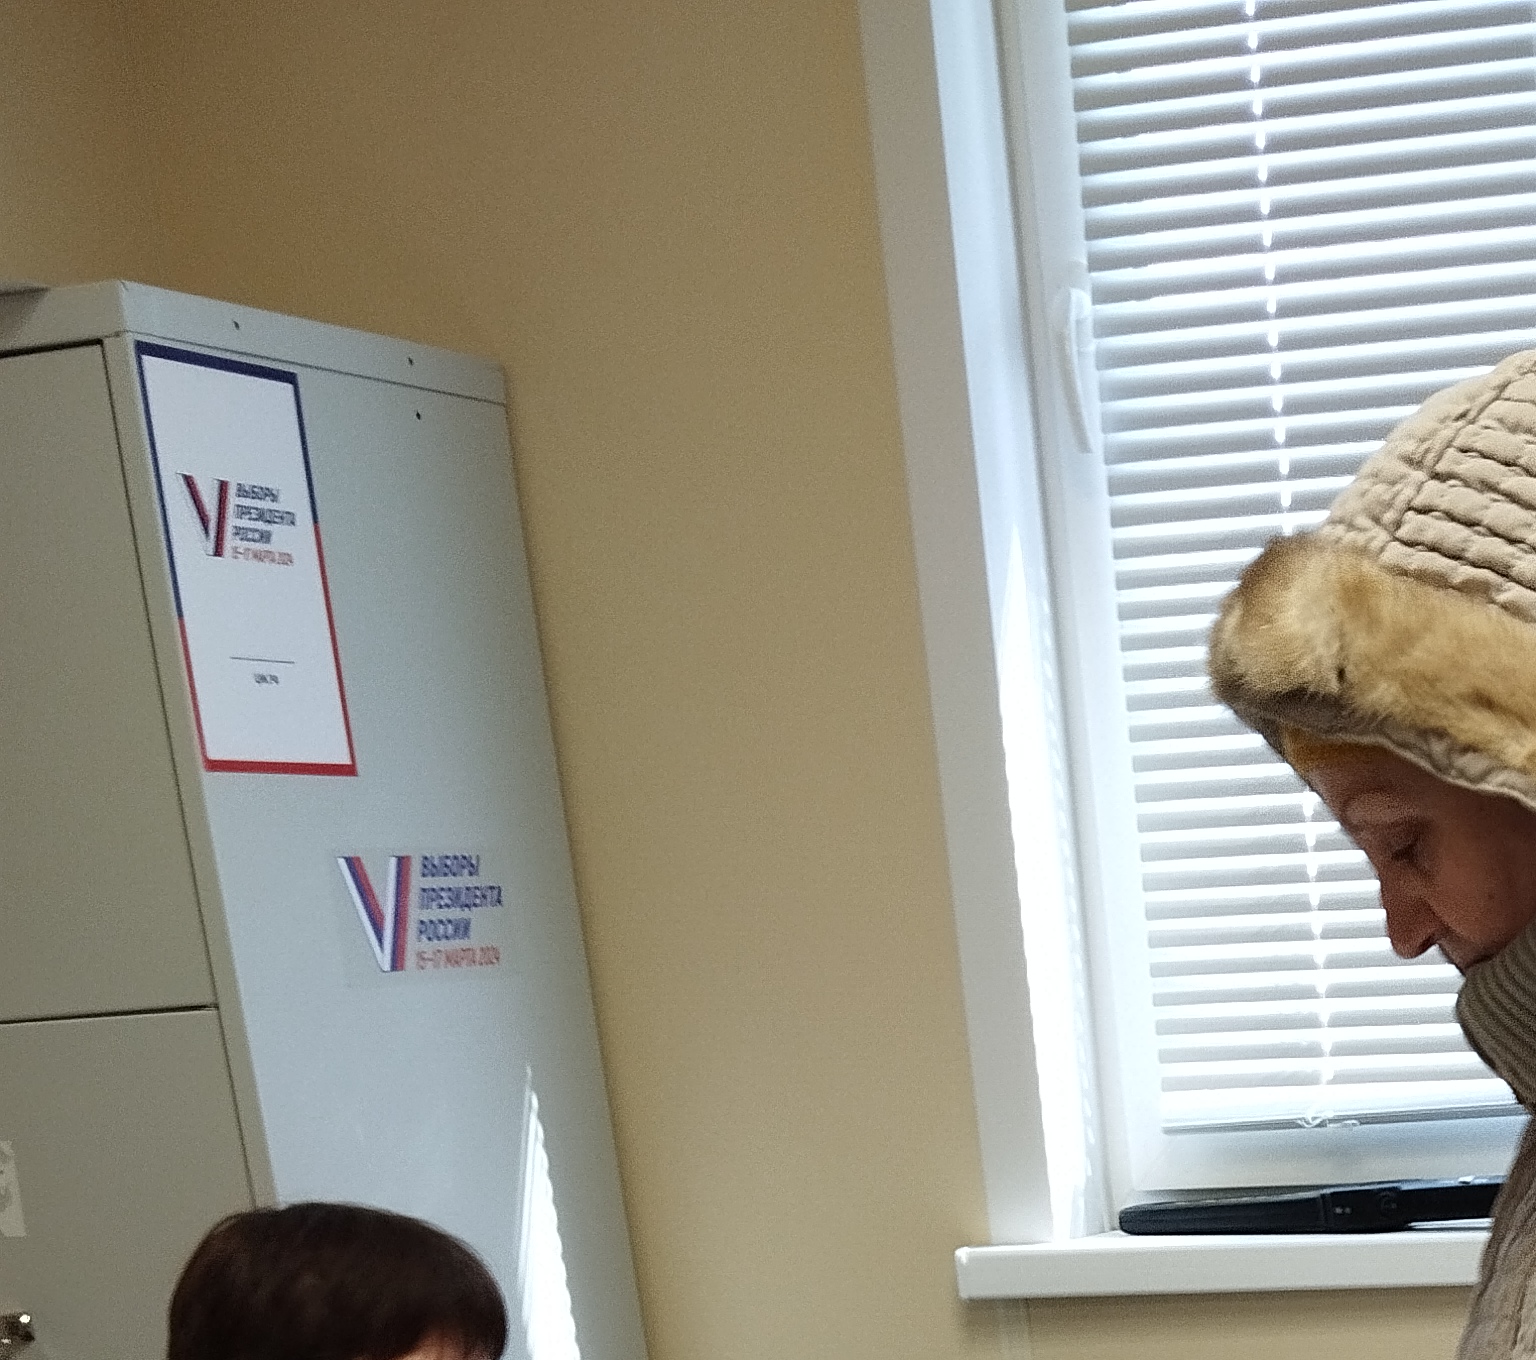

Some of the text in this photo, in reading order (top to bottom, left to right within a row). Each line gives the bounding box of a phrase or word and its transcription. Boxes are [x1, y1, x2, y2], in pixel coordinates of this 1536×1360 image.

[421, 854, 480, 877] ВЫБОРЫ
[419, 885, 503, 911] ПРЕЗИДЕНТА
[417, 918, 471, 941] РОССИИ
